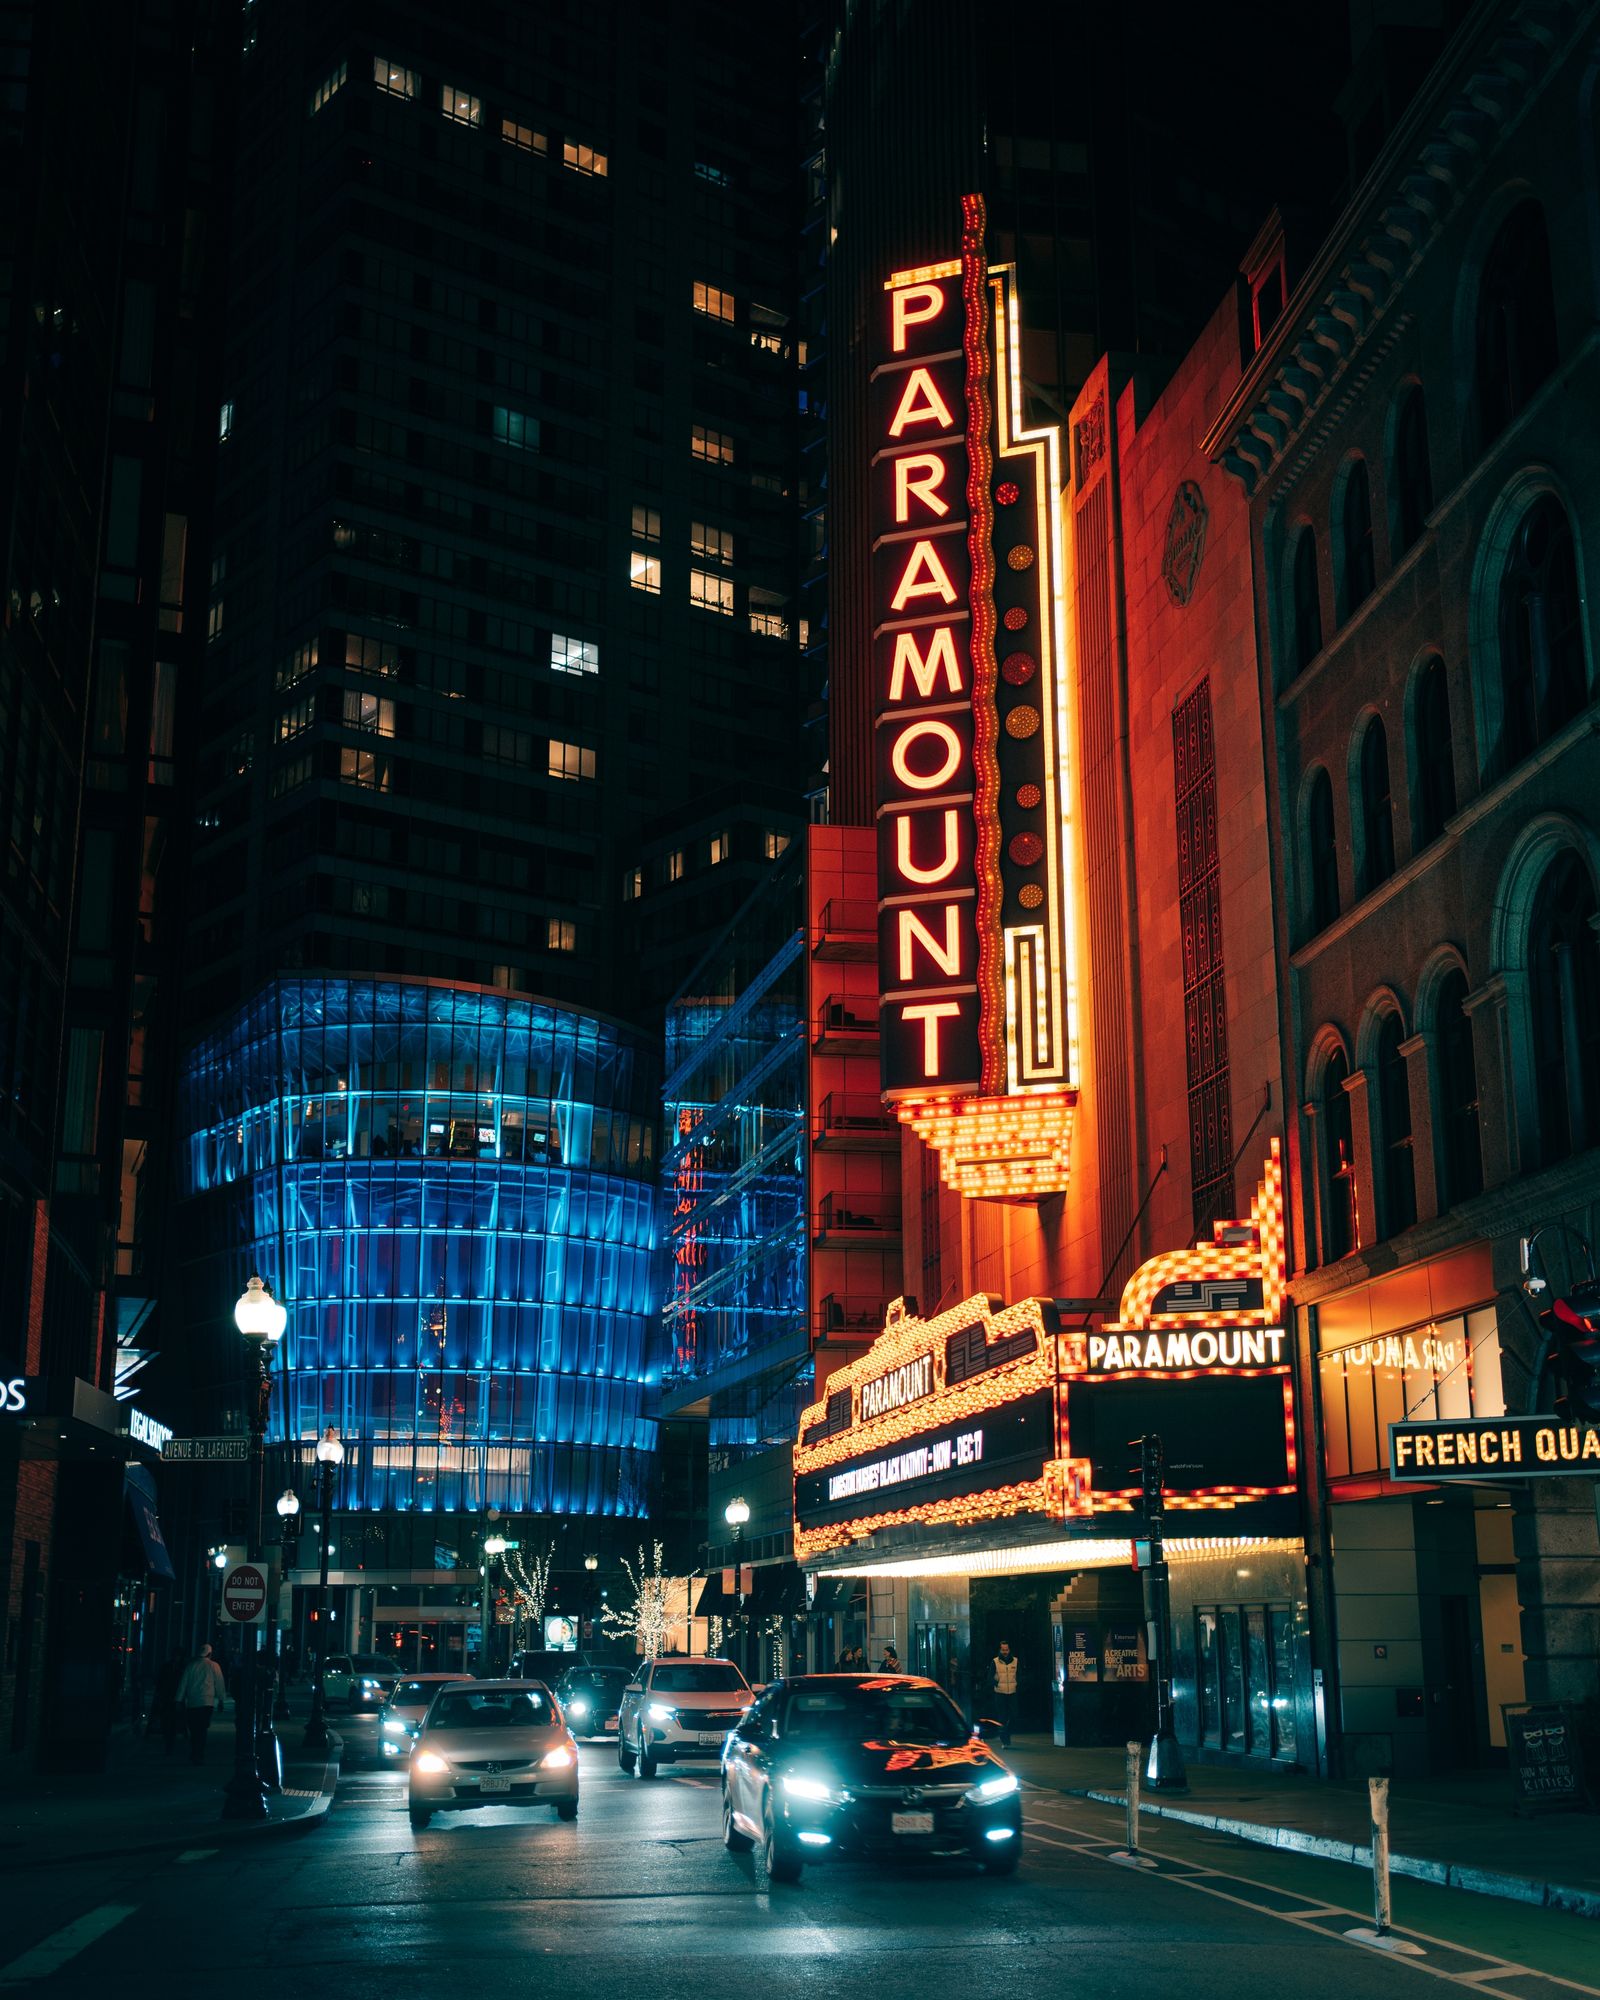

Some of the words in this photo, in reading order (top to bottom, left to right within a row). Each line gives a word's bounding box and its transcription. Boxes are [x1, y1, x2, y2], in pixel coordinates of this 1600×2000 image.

[889, 284, 963, 1078] PARAMOUNT
[1089, 1329, 1285, 1369] PARAMOUNT
[862, 1354, 931, 1421] PARAMOUNT
[165, 1442, 192, 1458] AVENUE
[195, 1442, 205, 1458] De
[208, 1442, 245, 1458] LAFAYETTE
[880, 1455, 900, 1487] BLACK
[900, 1447, 928, 1481] NATIVITY
[933, 1440, 951, 1472] NOW
[957, 1433, 975, 1465] DEC
[1395, 1429, 1522, 1467] FRENCH
[1535, 1427, 1600, 1462] QUA
[232, 1577, 242, 1586] DO
[244, 1577, 259, 1586] NOT
[232, 1602, 255, 1611] ENTER
[1110, 1649, 1138, 1657] CREATIVE
[1116, 1664, 1145, 1678] ARTS
